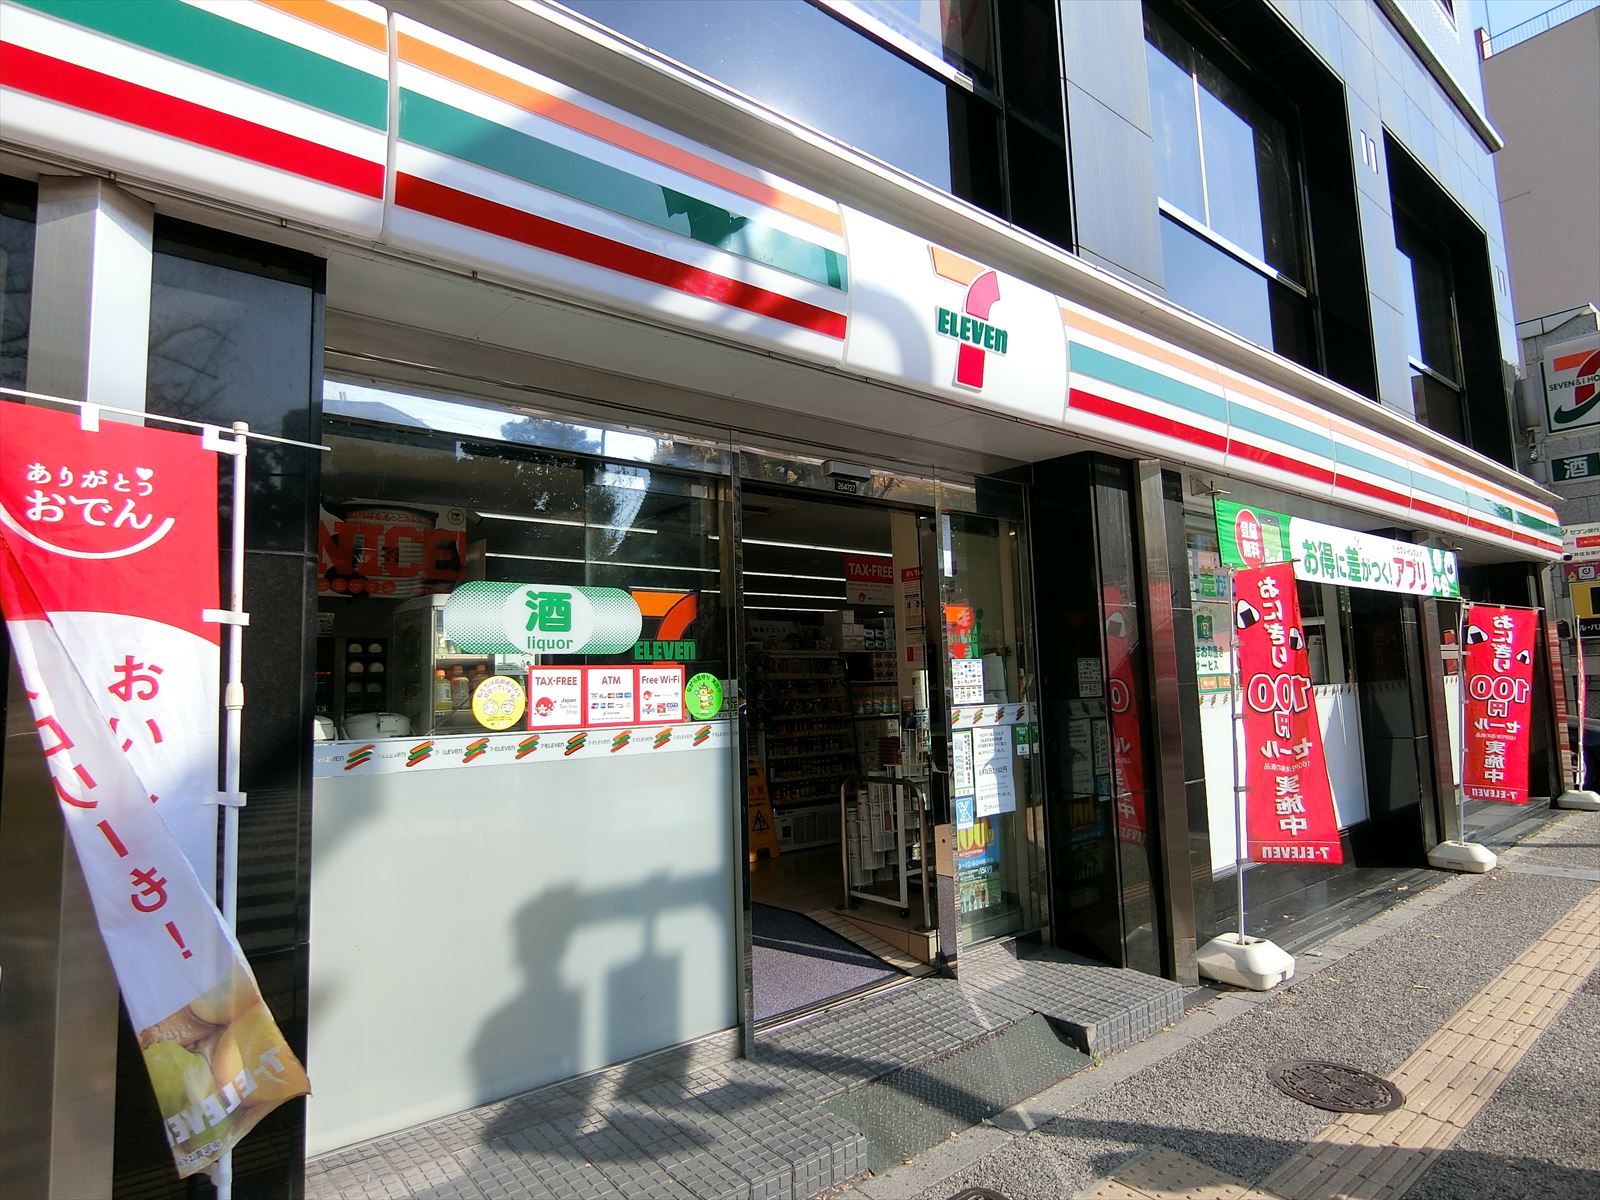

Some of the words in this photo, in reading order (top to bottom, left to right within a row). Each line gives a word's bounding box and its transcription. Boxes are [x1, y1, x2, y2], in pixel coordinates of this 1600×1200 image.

[938, 307, 1008, 354] ELEVEN
[1563, 456, 1589, 479] 酒
[27, 463, 154, 497] ありがとう
[25, 490, 154, 530] おでん
[525, 590, 572, 632] 酒
[527, 636, 574, 652] liquor
[634, 640, 696, 661] ELEVEN
[601, 676, 621, 685] ATM
[641, 675, 658, 684] Free
[660, 675, 680, 684] Wi-Fi
[540, 741, 565, 749] 7-ELEVEN
